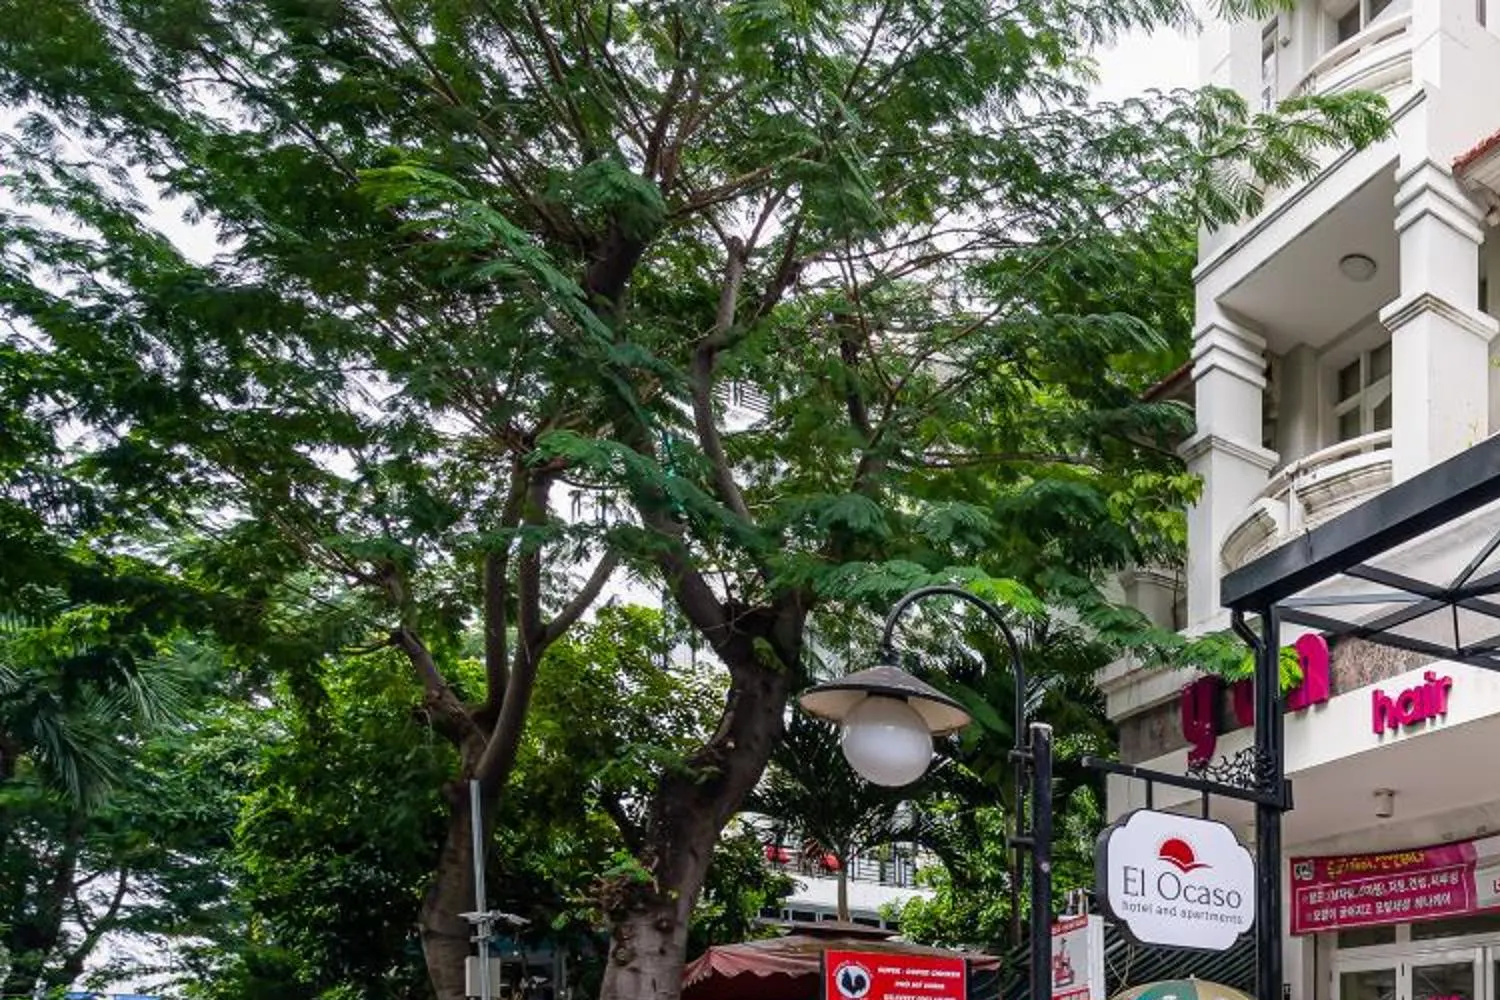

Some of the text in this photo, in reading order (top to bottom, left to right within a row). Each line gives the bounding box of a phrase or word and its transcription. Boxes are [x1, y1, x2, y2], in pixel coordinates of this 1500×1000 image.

[1372, 671, 1452, 735] hair
[1123, 866, 1242, 909] El Ocaso
[1121, 901, 1244, 925] hotel and apartments
